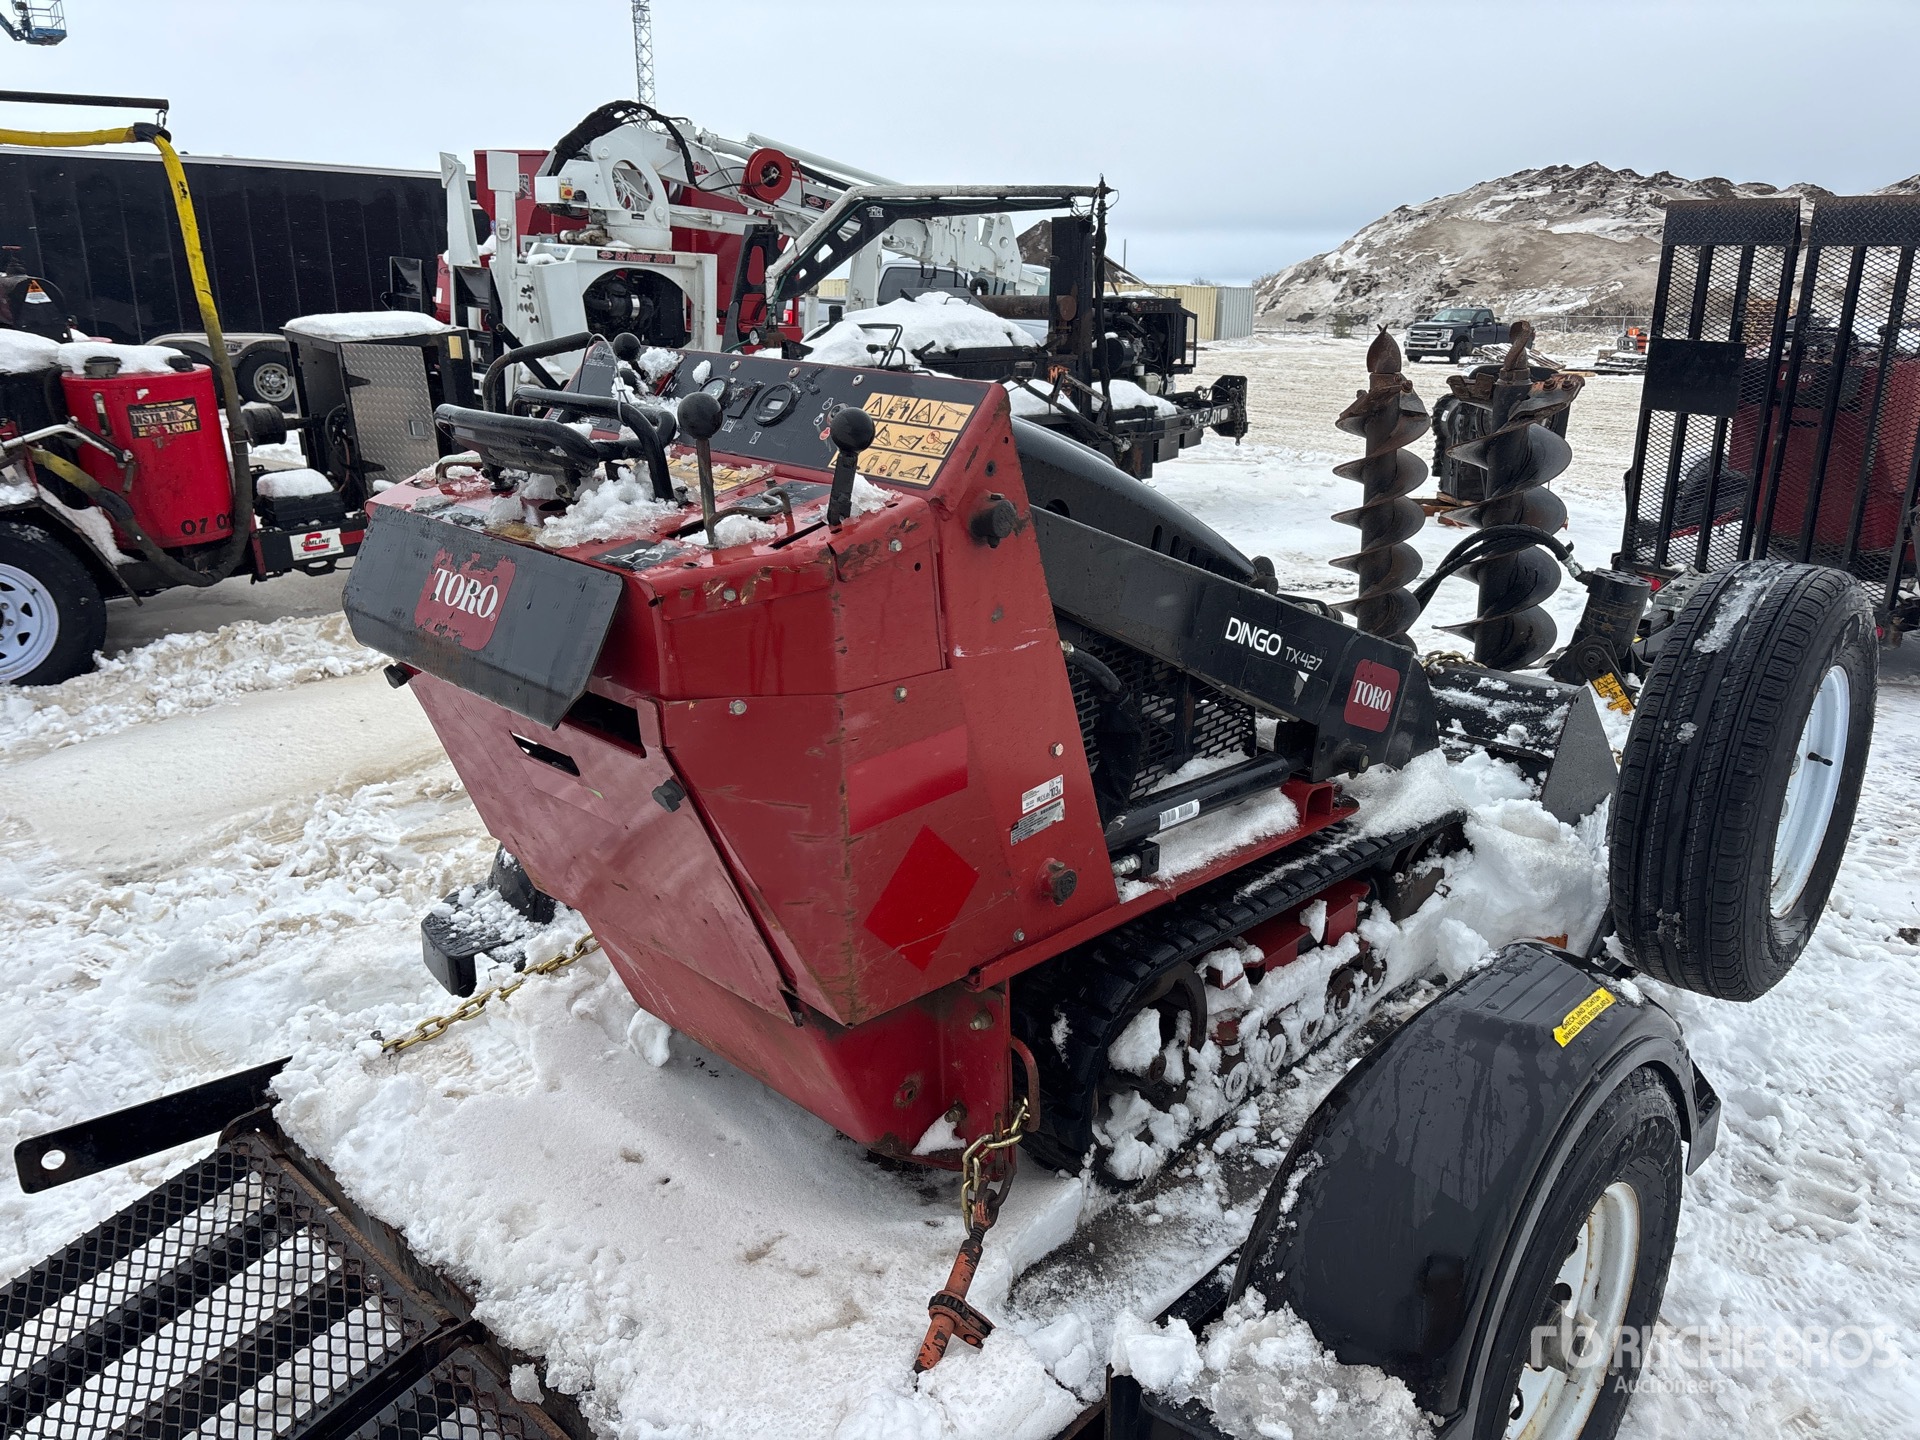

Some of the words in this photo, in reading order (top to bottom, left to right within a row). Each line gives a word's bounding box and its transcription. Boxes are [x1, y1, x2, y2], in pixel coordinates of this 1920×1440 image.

[181, 518, 208, 536] 07
[301, 537, 331, 548] CIMLINE
[433, 567, 499, 619] TORO
[1225, 617, 1282, 656] DINGO
[1353, 680, 1392, 712] TORO
[1562, 1015, 1576, 1030] CHECK
[1563, 1024, 1580, 1040] WHEEL
[1577, 1014, 1591, 1028] NUTS
